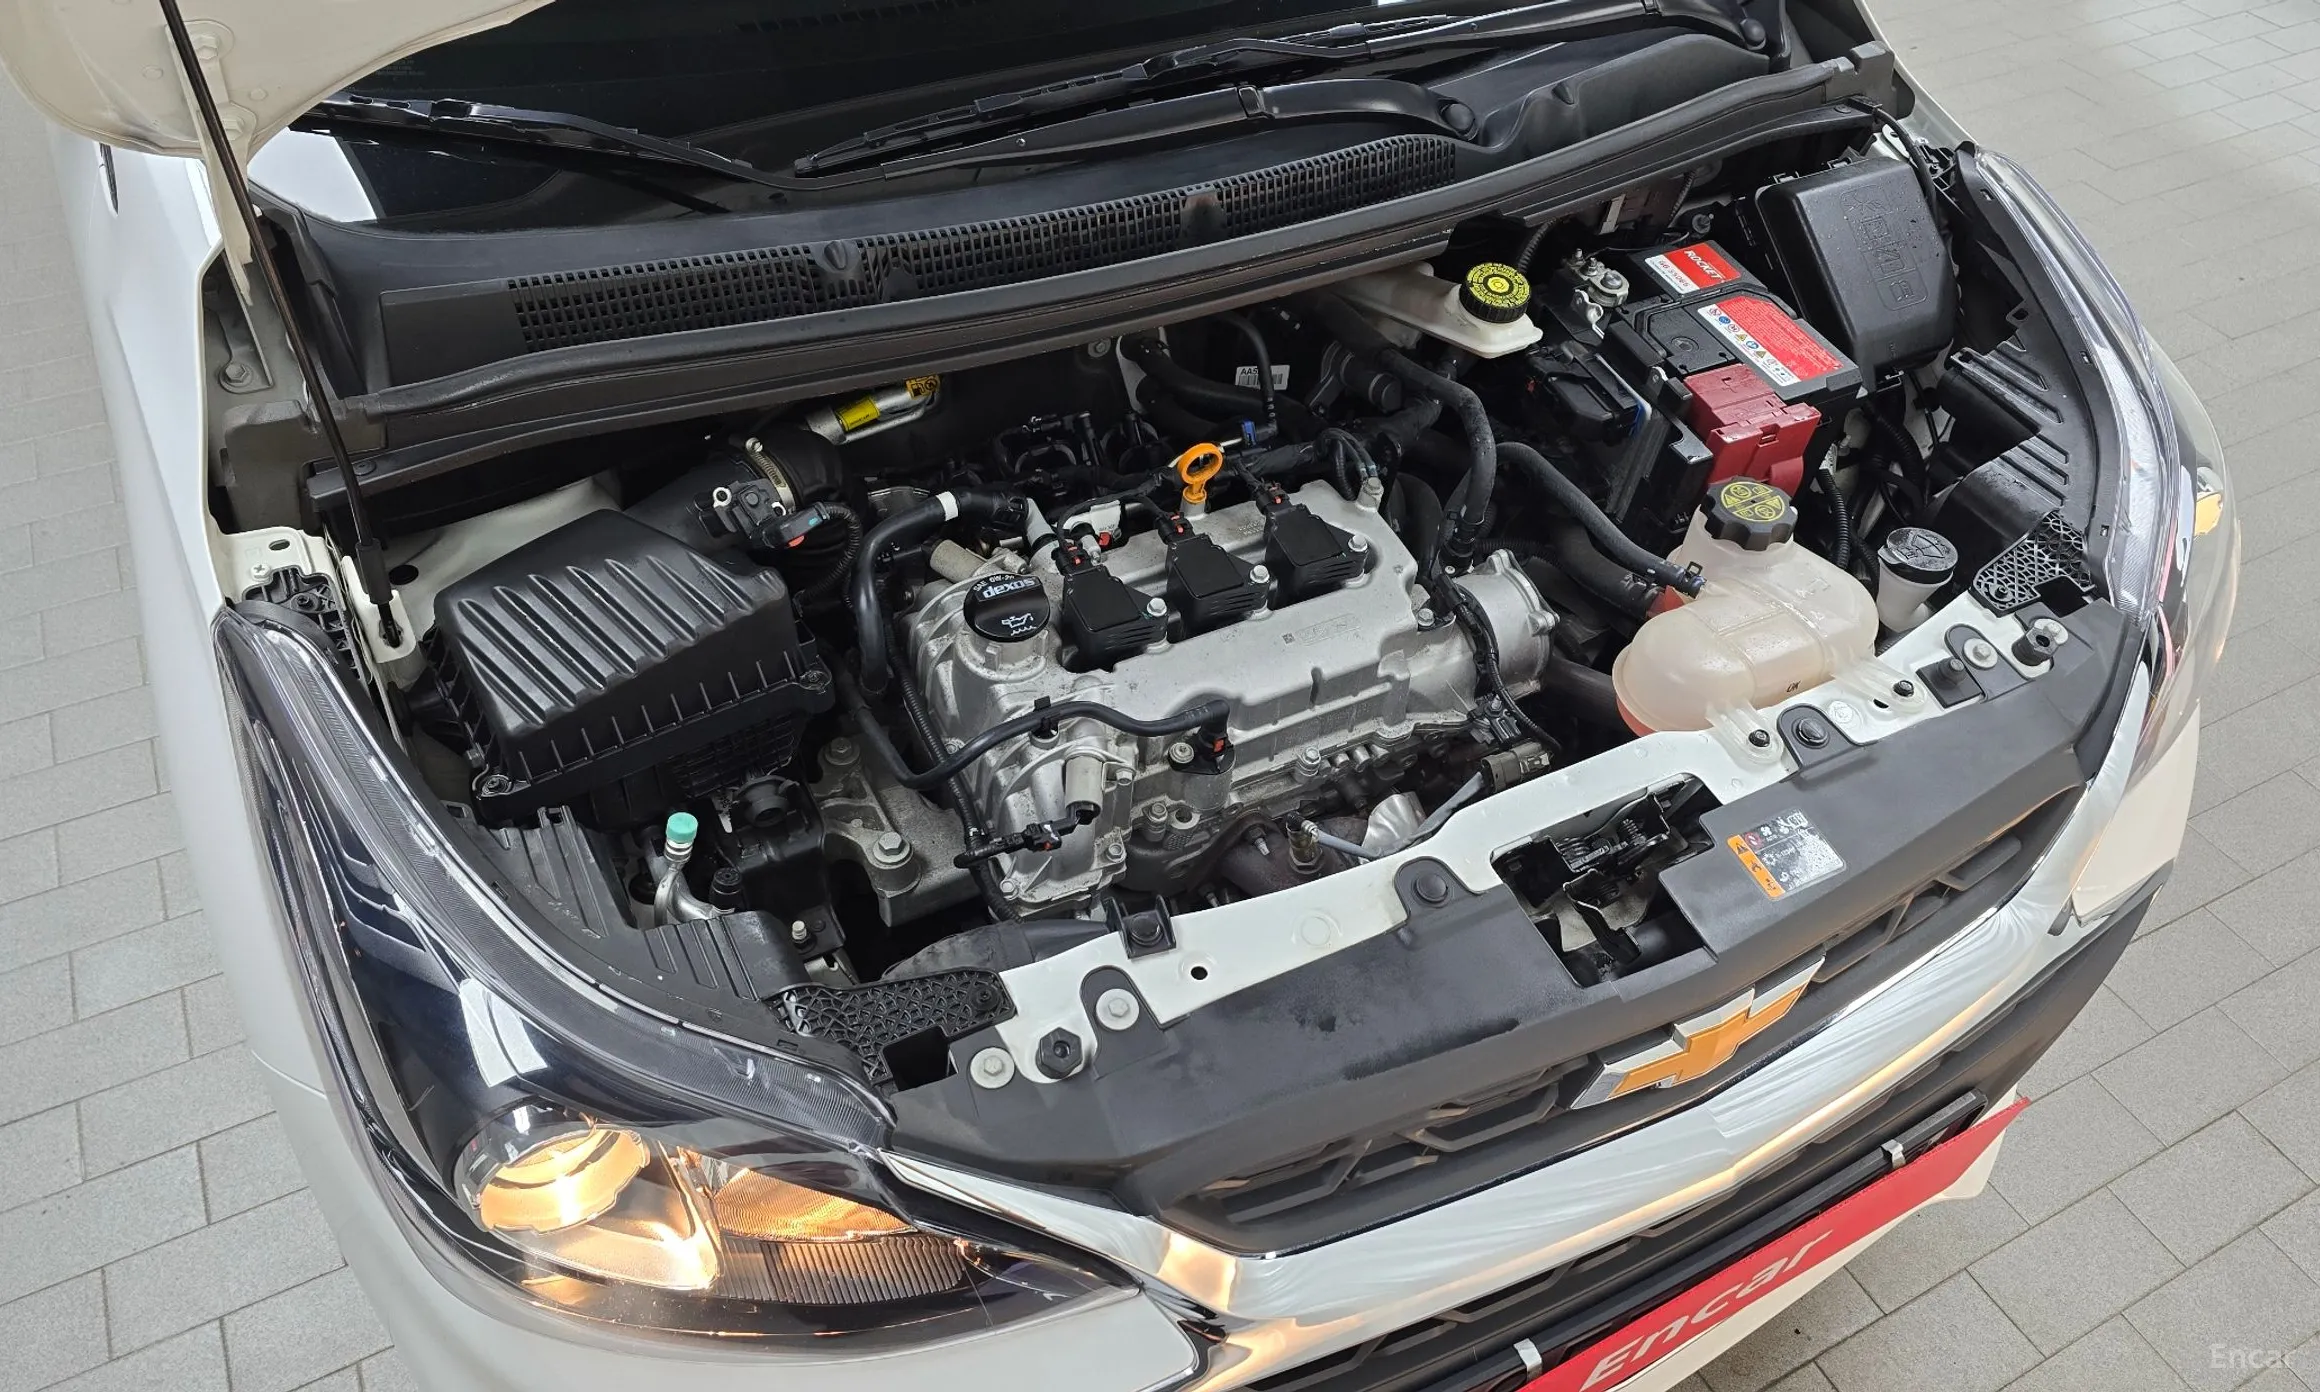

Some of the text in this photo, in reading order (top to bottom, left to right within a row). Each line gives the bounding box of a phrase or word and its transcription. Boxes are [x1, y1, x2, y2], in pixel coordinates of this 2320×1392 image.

[1683, 249, 1723, 282] ROCKET
[973, 580, 987, 591] SAE
[982, 577, 1035, 599] dexos
[1579, 1229, 1833, 1392] Encar
